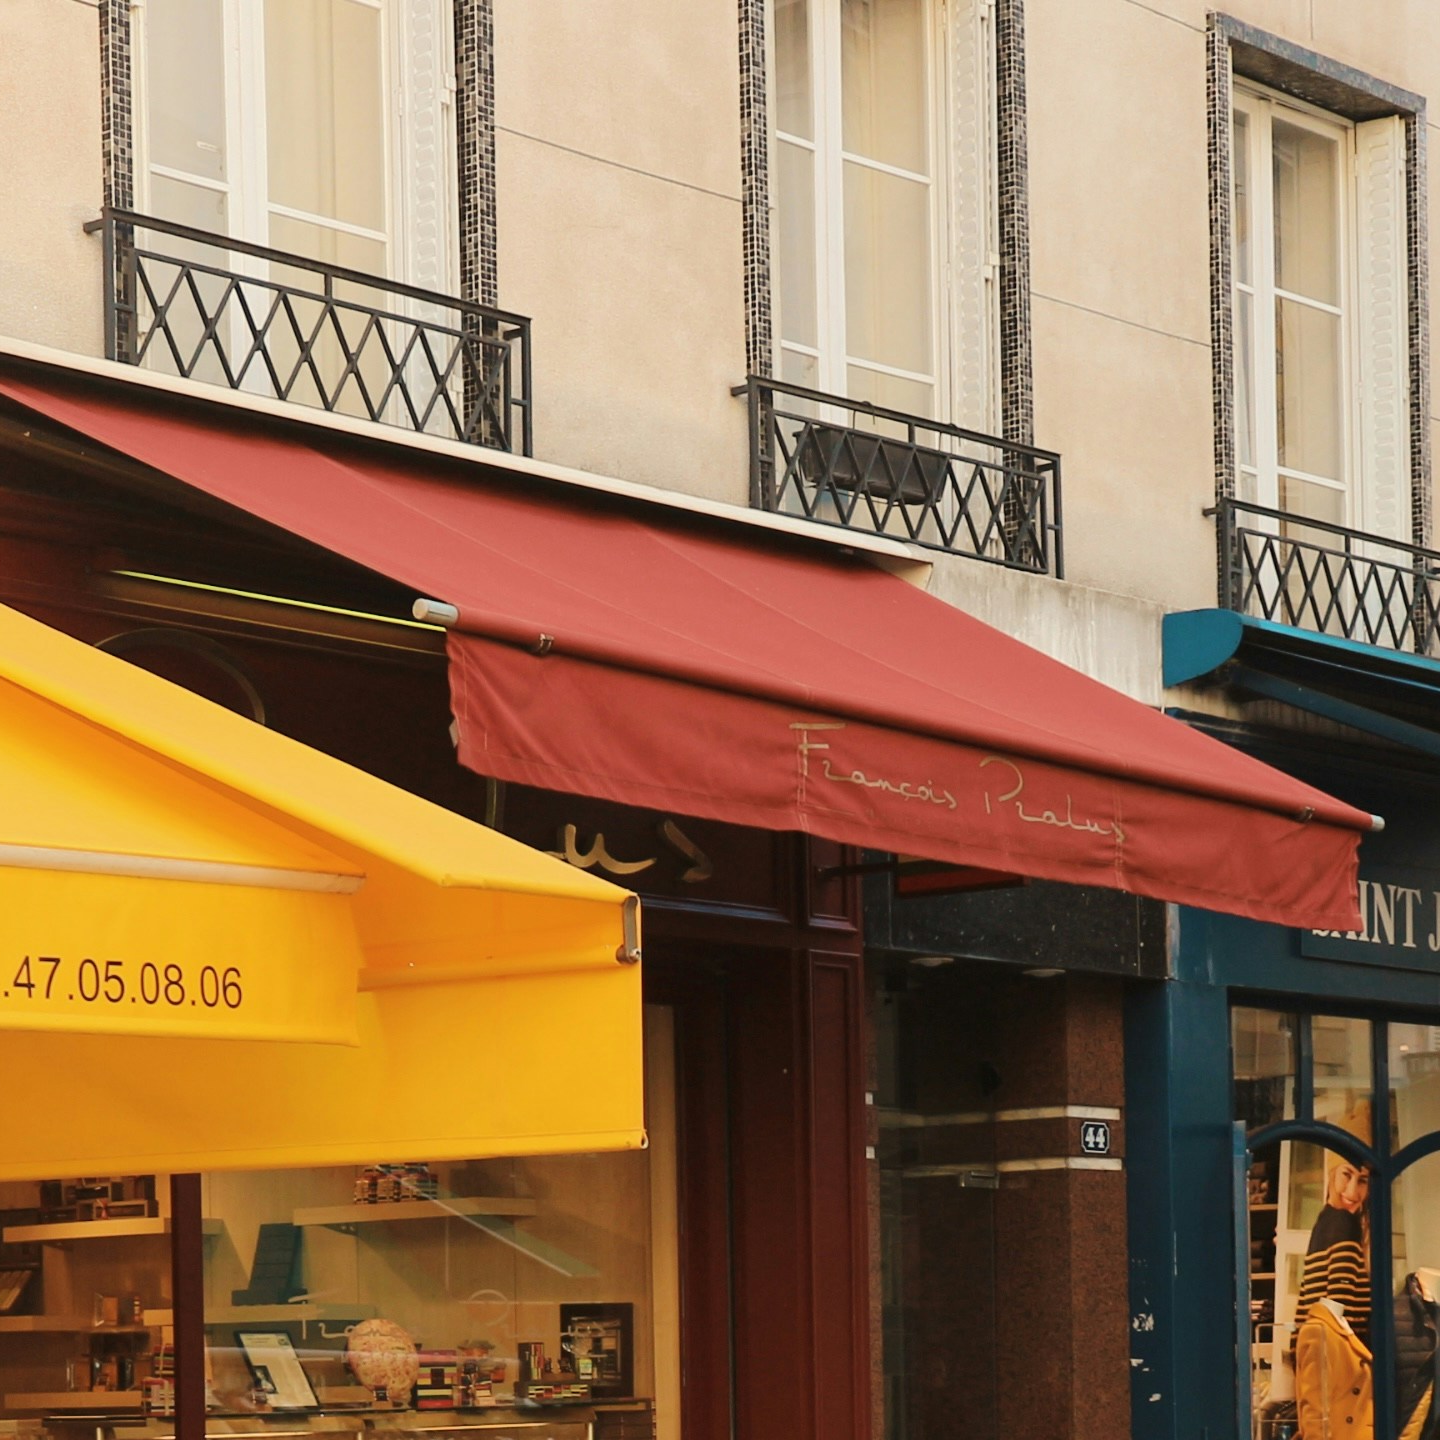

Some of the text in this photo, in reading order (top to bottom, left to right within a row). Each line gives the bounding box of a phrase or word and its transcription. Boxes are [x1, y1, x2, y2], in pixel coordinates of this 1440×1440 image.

[789, 722, 1125, 843] François Pralus
[1312, 880, 1422, 948] INT
[1085, 1127, 1106, 1149] 44
